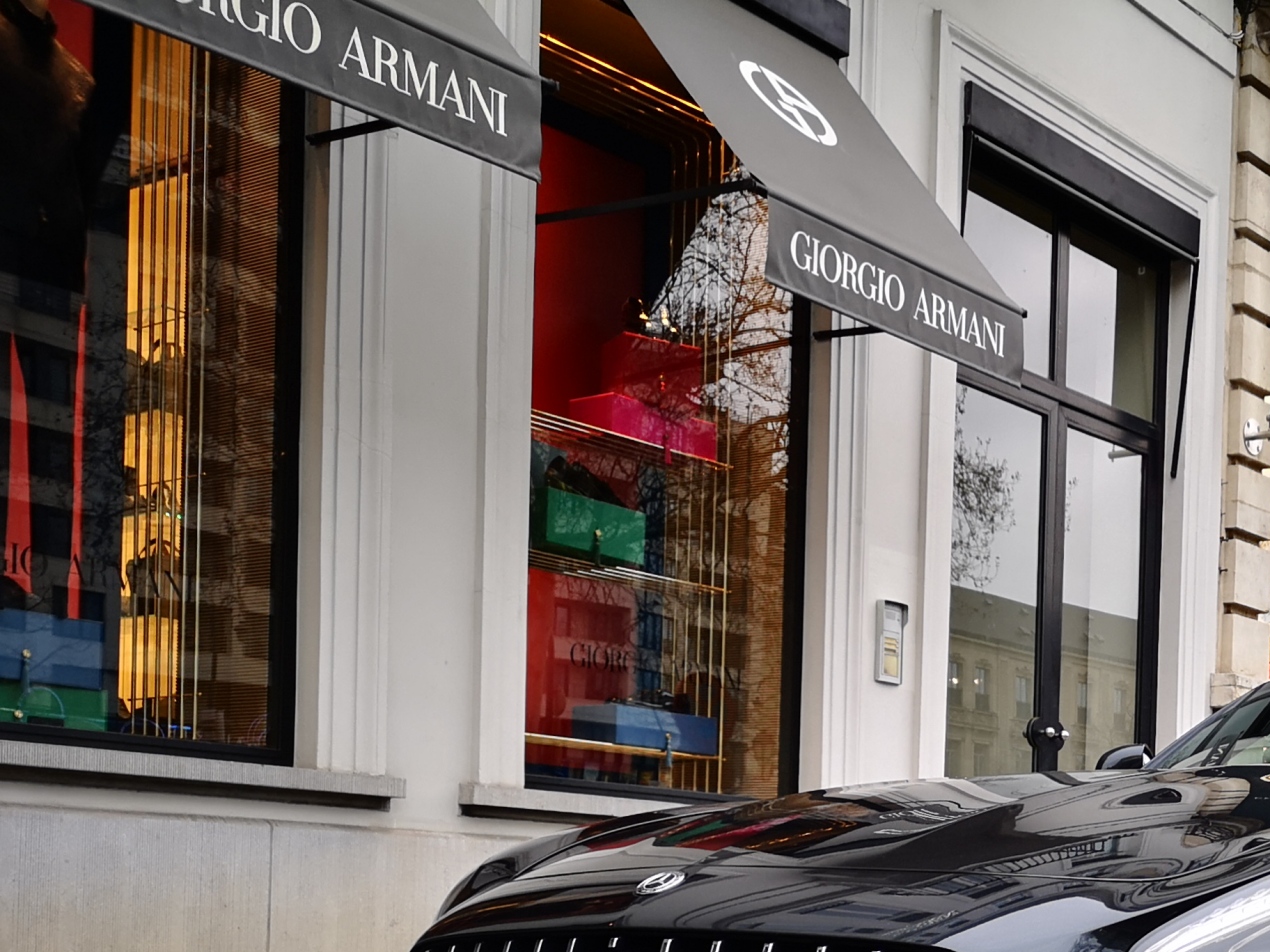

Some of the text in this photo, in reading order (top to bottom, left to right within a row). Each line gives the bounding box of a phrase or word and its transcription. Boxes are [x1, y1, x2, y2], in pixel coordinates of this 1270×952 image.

[338, 26, 508, 137] ARMANI
[790, 231, 1006, 358] GIORGIO ARMANI
